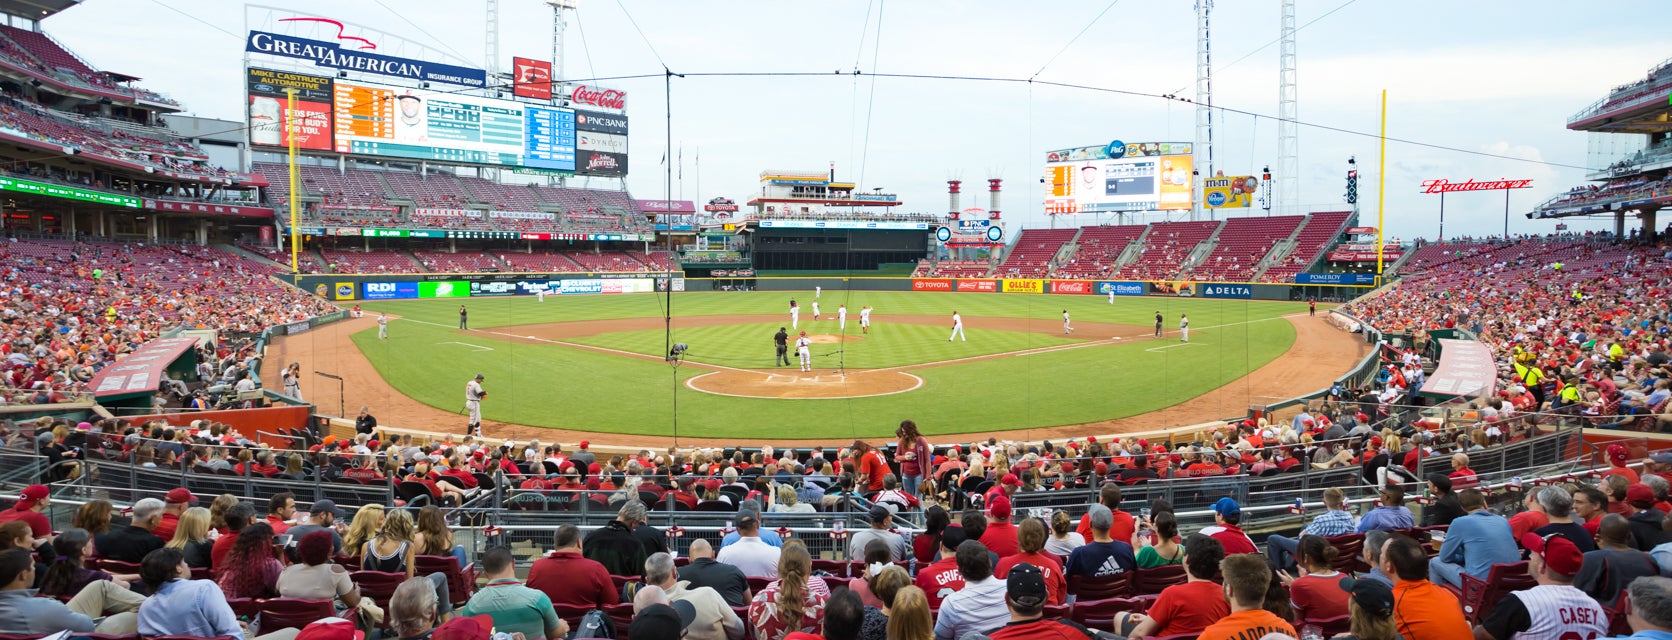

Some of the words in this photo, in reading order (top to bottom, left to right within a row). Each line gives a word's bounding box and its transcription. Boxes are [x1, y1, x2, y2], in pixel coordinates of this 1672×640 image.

[252, 33, 327, 59] GREAT
[321, 48, 422, 77] AMERICAN
[250, 70, 274, 78] MIKE
[277, 73, 328, 84] CASTRUCCI
[427, 72, 462, 83] INSURANCE
[261, 77, 320, 90] AUTOMOTIVE
[284, 109, 305, 118] RDS
[284, 116, 303, 125] TIS
[304, 119, 328, 128] BUD'S
[587, 116, 604, 126] PNC
[605, 118, 627, 128] BANK
[302, 126, 320, 135] YOU.
[591, 138, 624, 147] DYNEGY
[1422, 177, 1531, 194] Budweiser
[367, 282, 396, 292] RDI
[1559, 608, 1598, 625] CASEY
